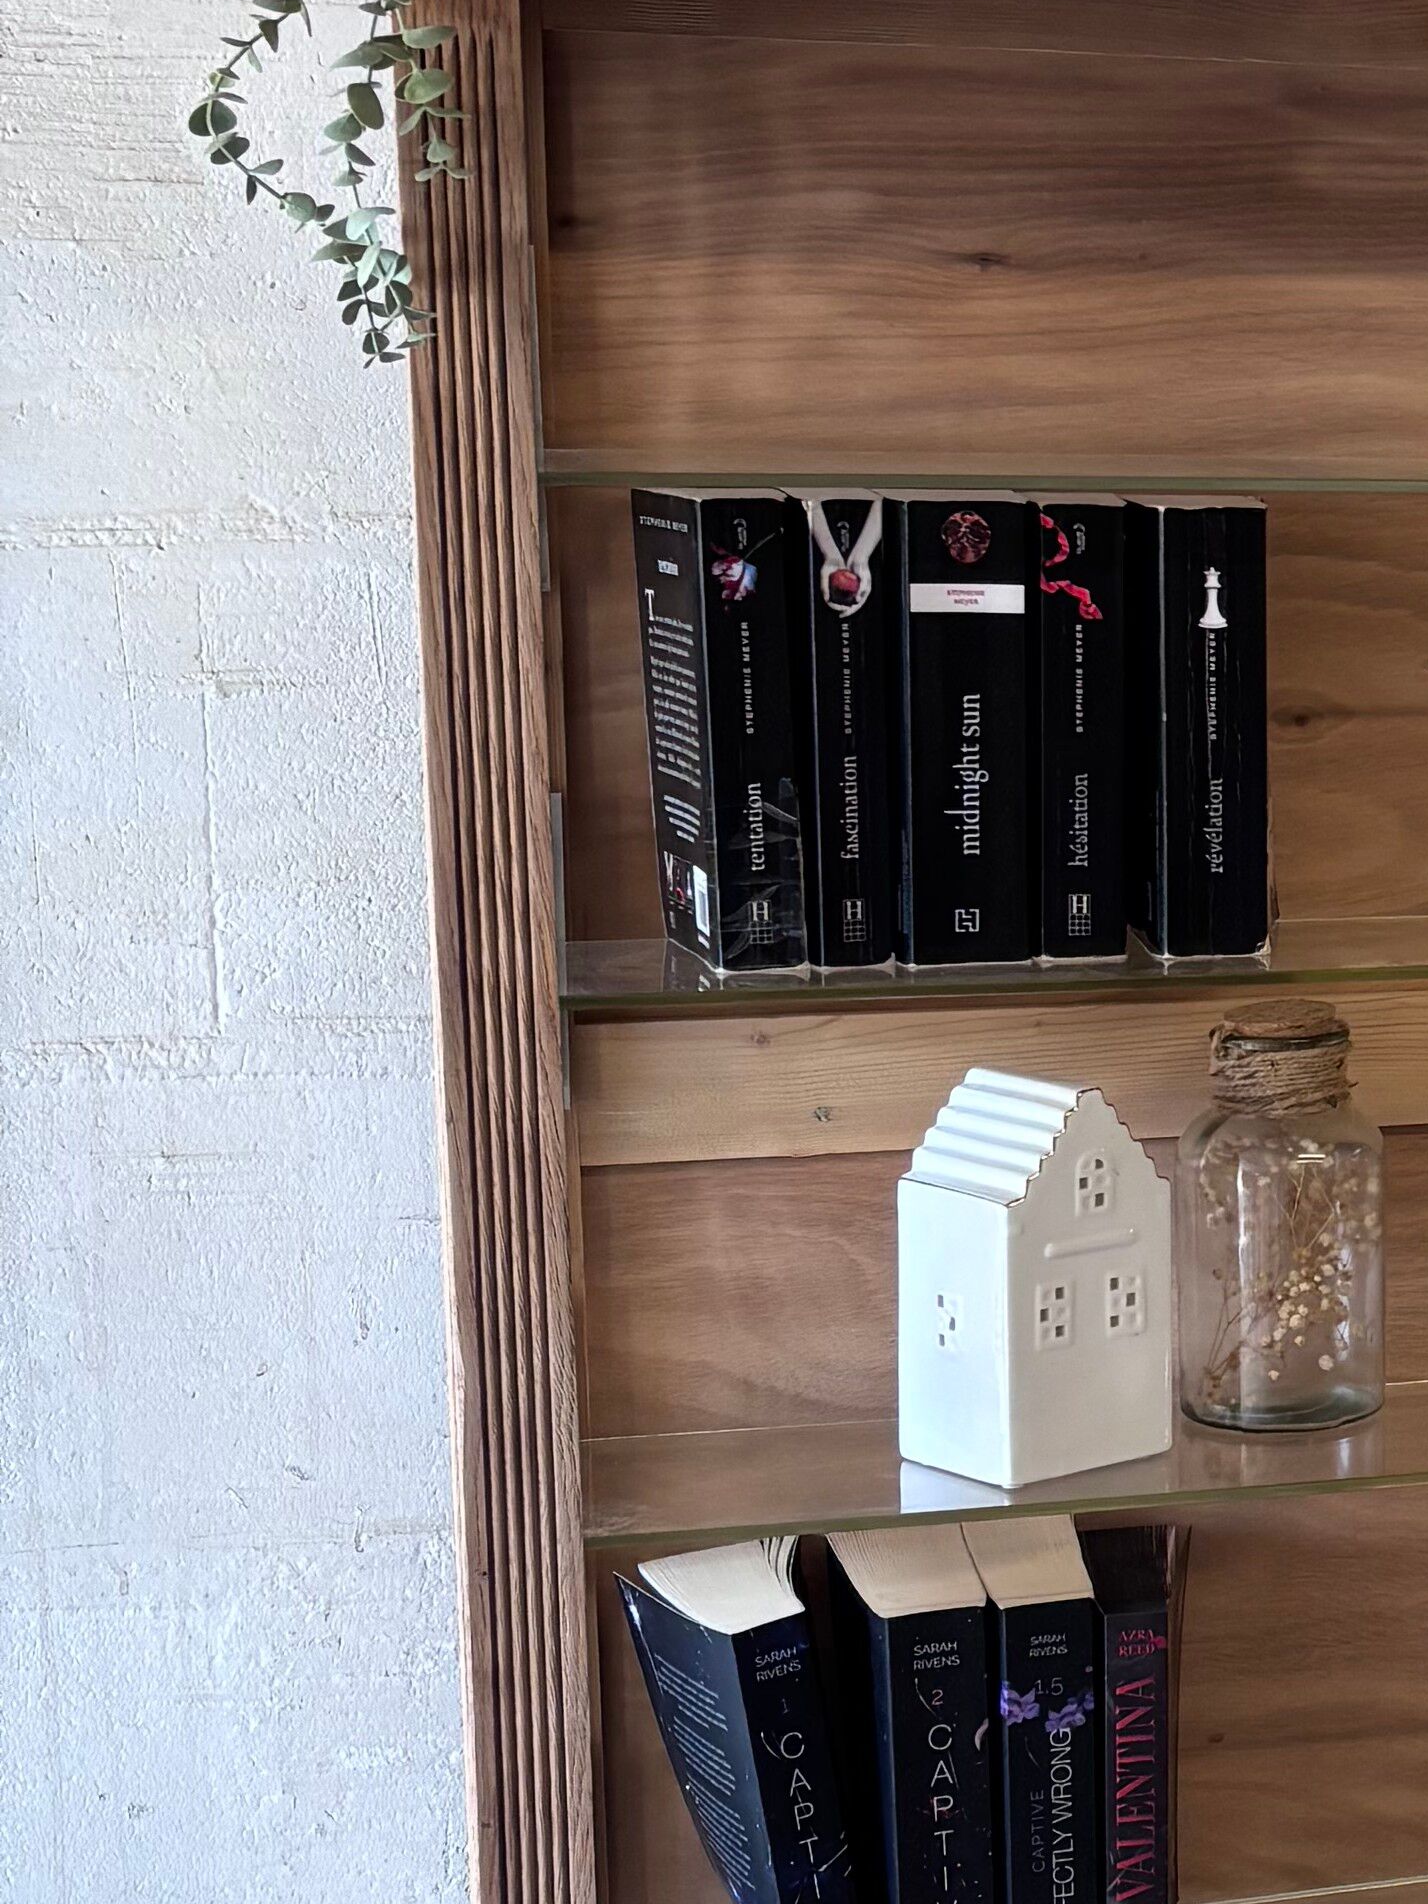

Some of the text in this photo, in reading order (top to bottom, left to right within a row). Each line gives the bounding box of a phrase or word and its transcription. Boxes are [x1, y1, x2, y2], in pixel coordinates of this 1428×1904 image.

[943, 693, 990, 856] midnight sun
[743, 782, 766, 871] tentation
[840, 755, 860, 860] fascination
[1067, 773, 1089, 867] hésitation
[1202, 778, 1224, 874] révélation
[754, 1646, 798, 1668] SARAH
[756, 1659, 802, 1682] RIVENS
[913, 1641, 958, 1657] SARAH
[913, 1654, 961, 1671] RIVENS
[1029, 1644, 1068, 1658] RIVENS
[781, 1698, 789, 1714] 1
[931, 1688, 944, 1706] 2
[1034, 1676, 1064, 1696] 1.5
[1050, 1727, 1073, 1824] WRONG
[1115, 1673, 1156, 1902] VALENTINA
[1030, 1789, 1046, 1874] CAPTIVE
